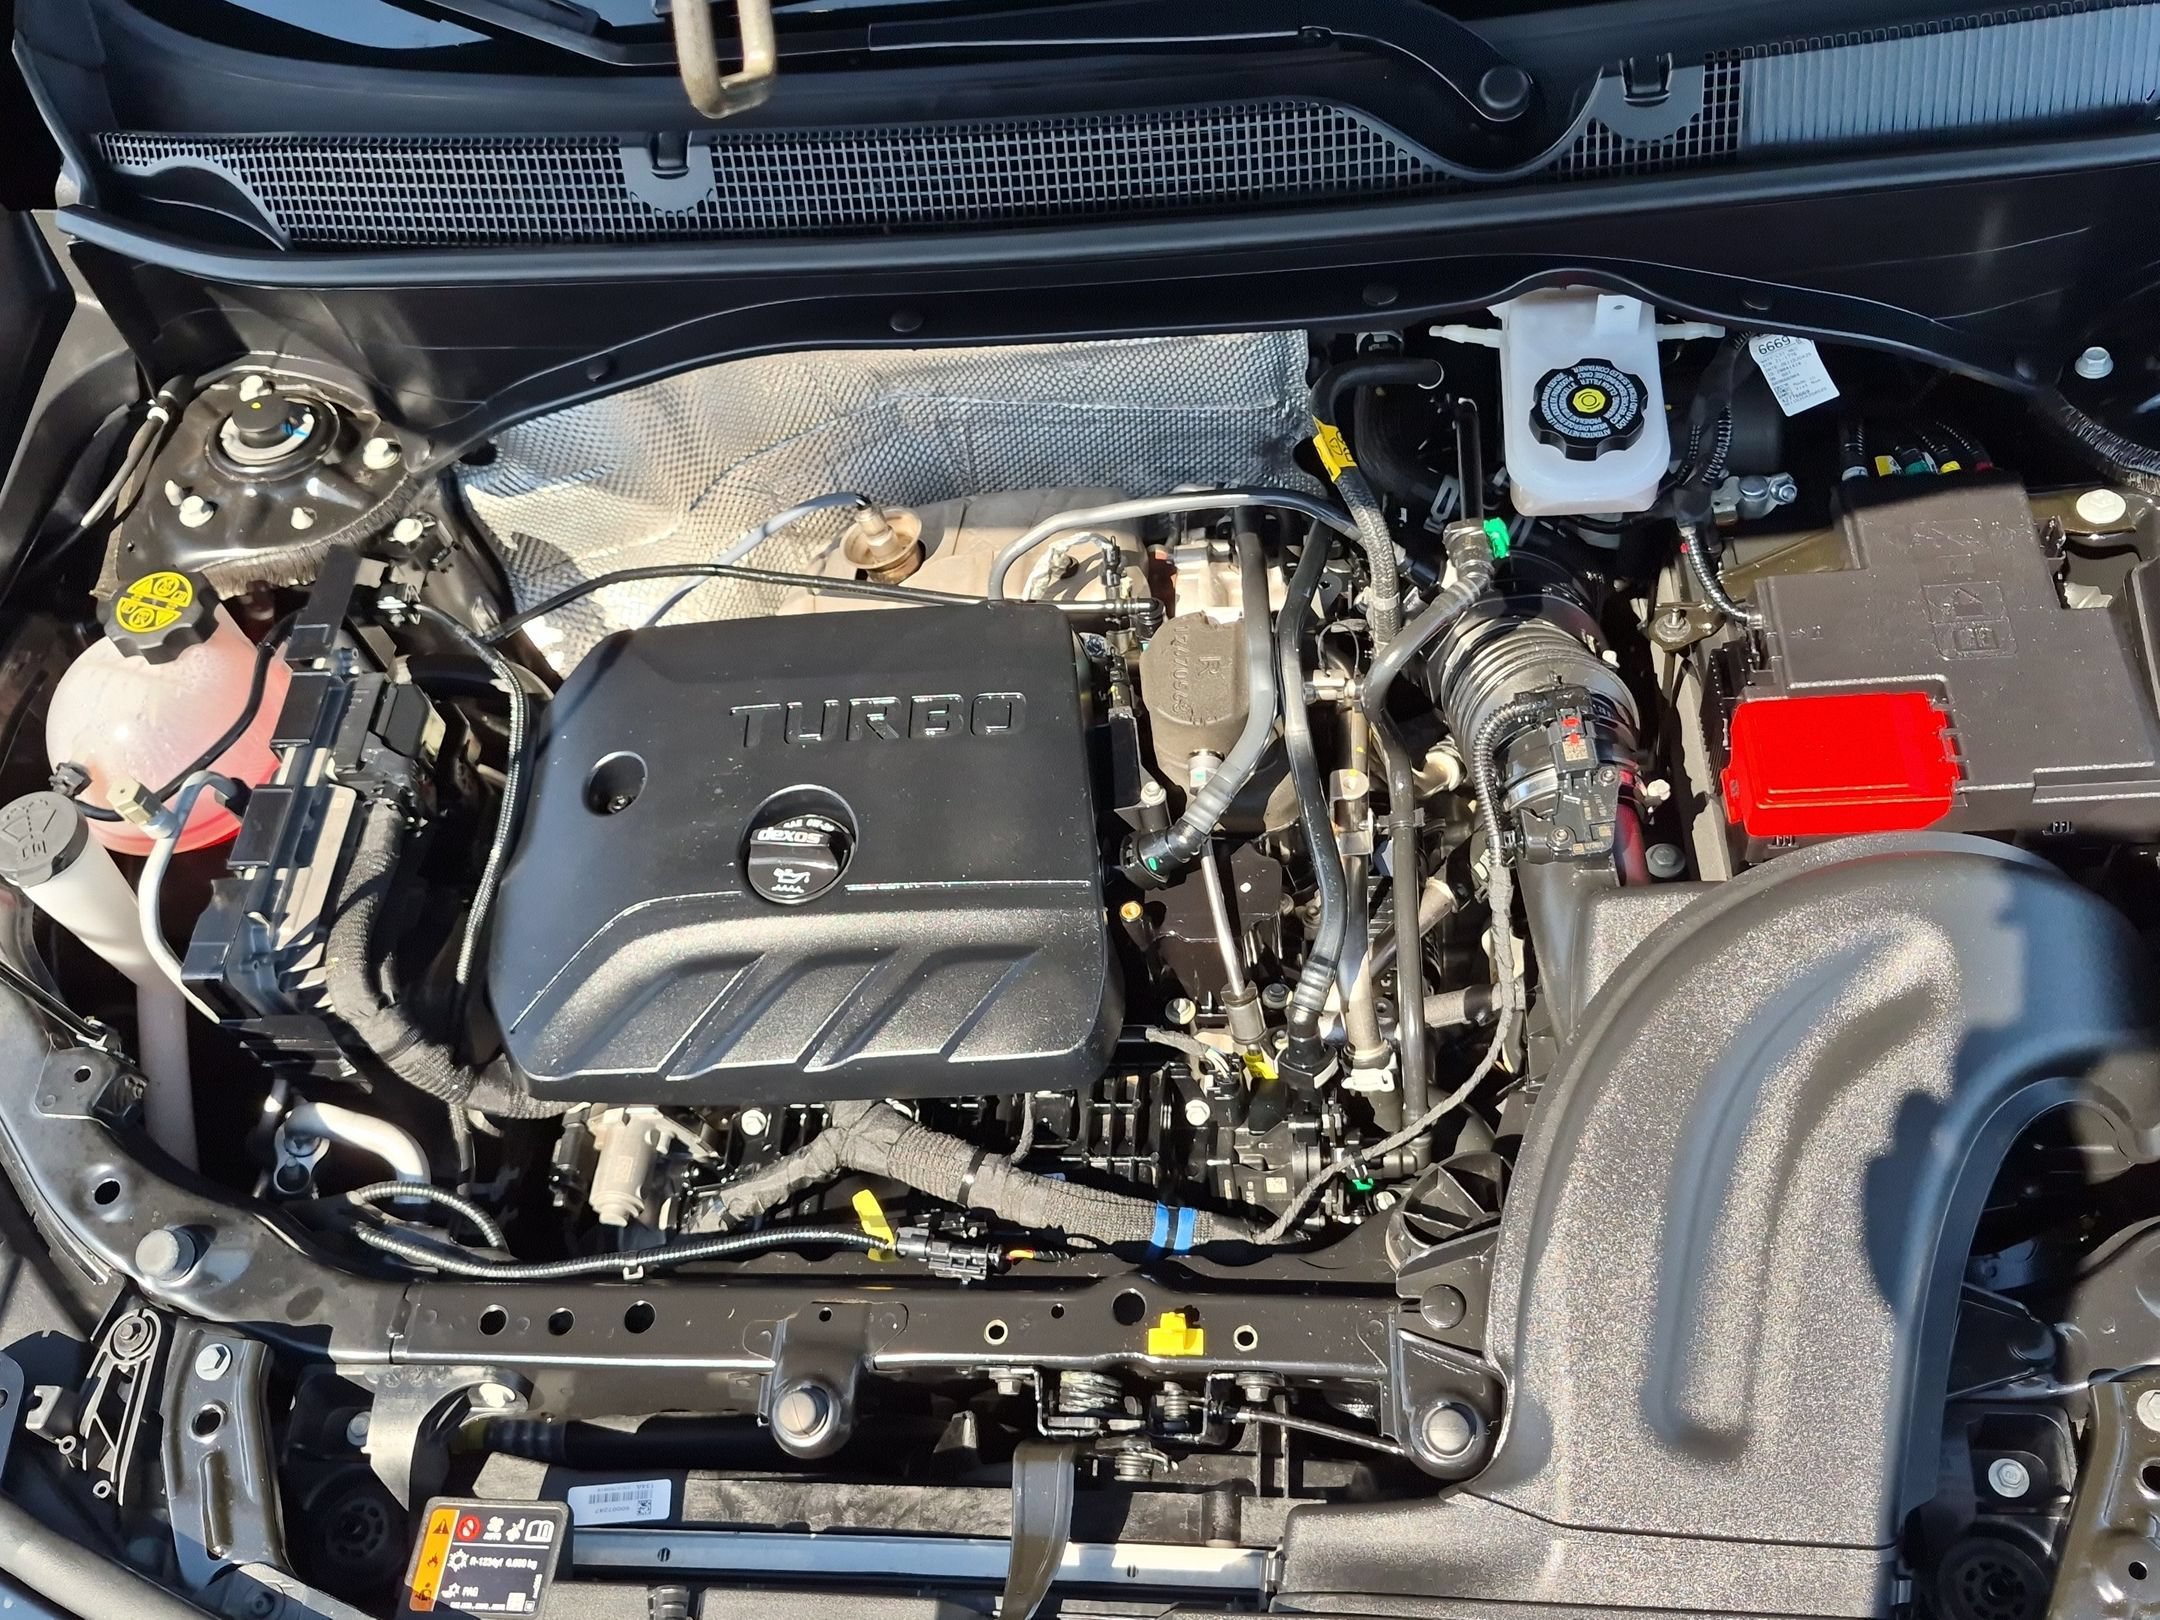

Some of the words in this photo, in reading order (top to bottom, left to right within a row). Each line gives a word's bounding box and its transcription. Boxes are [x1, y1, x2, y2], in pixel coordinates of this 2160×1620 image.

[1758, 336, 1791, 355] 6669
[730, 692, 1027, 748] TURBO
[757, 827, 824, 844] dexos
